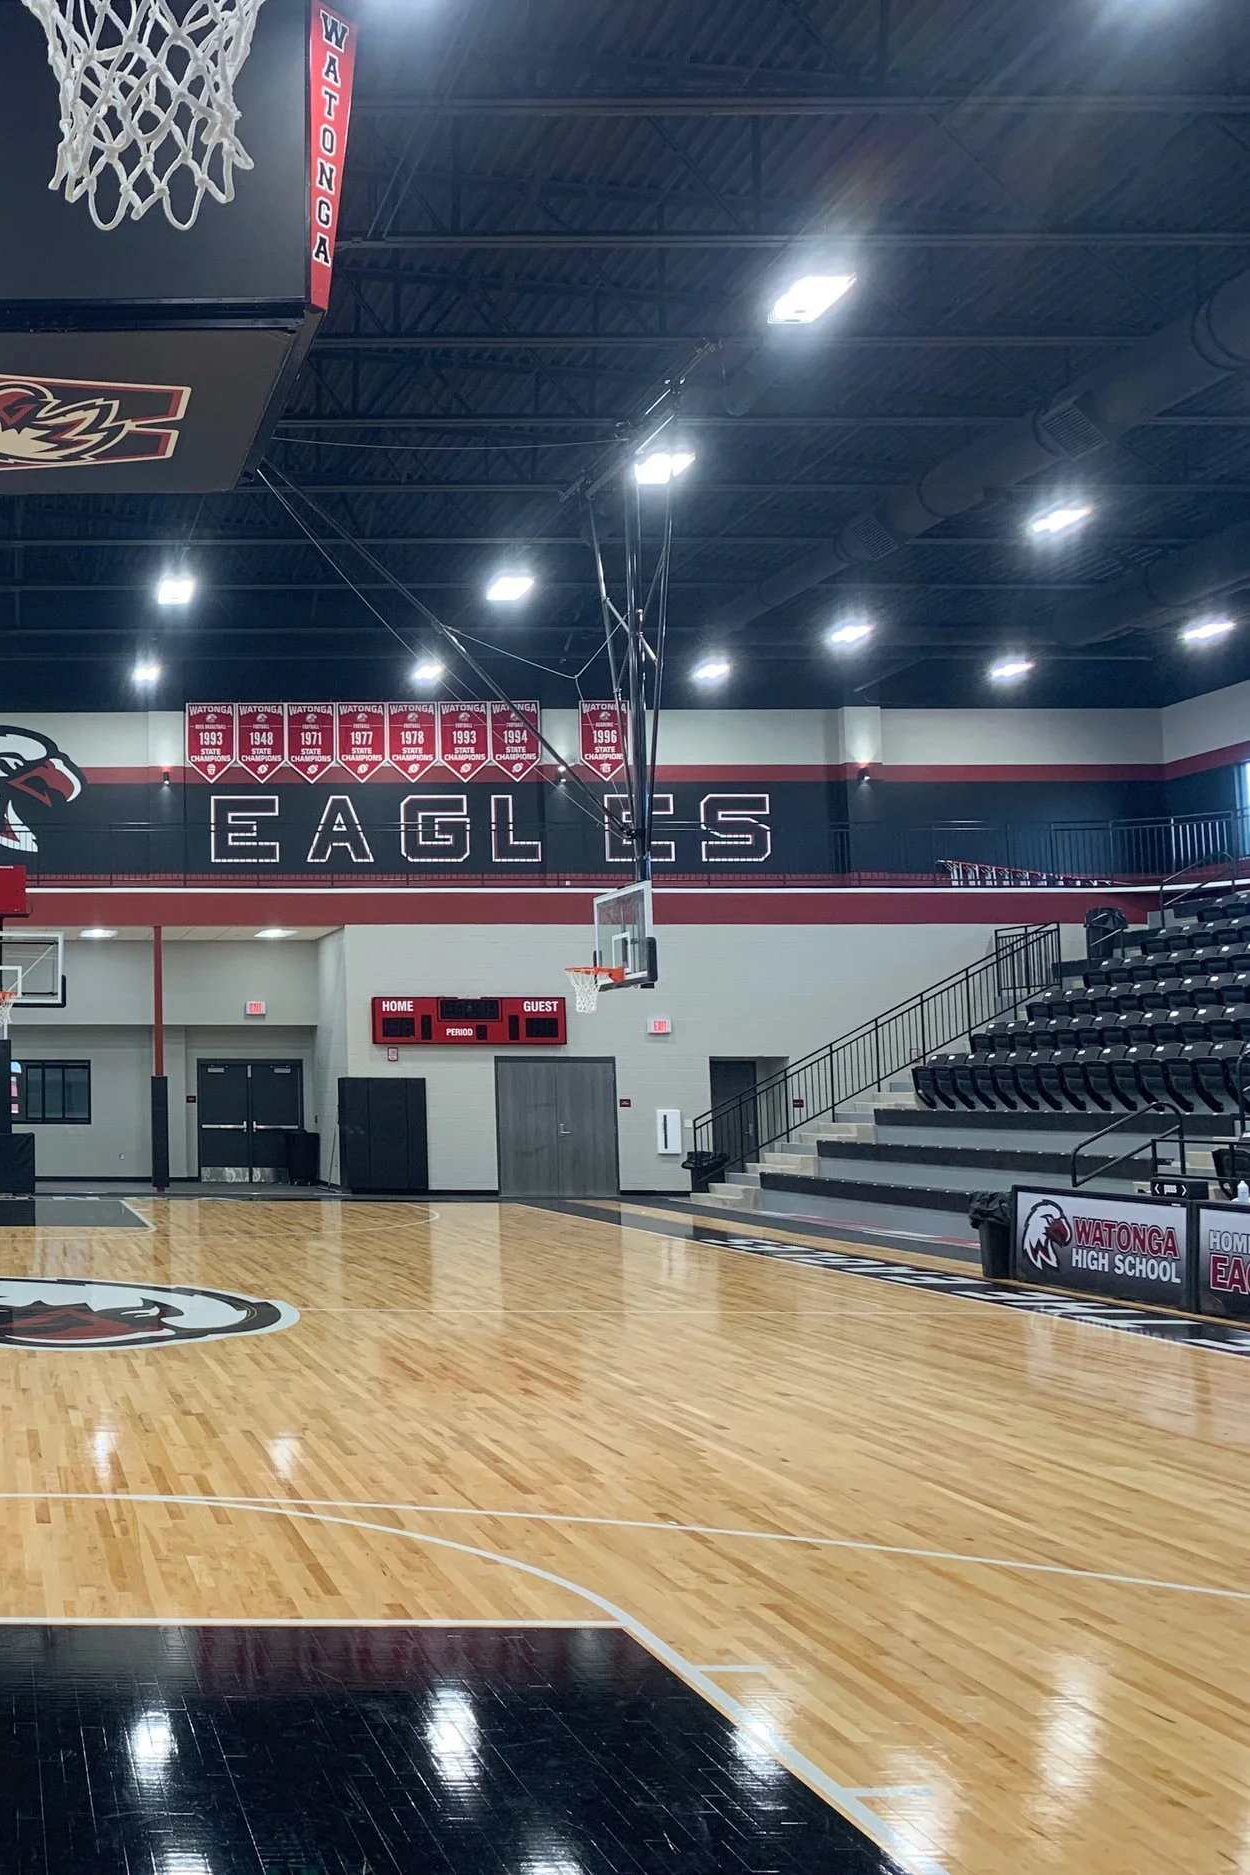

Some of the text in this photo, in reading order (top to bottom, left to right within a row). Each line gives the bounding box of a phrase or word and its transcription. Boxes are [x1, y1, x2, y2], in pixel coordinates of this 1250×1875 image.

[314, 8, 350, 268] WATONGA
[189, 706, 232, 716] WATONGA
[240, 706, 282, 716] WATONGA
[289, 706, 332, 716] WATONGA
[339, 705, 383, 715] WATONGA
[390, 704, 434, 715] WATONGA
[441, 704, 486, 714] WATONGA
[199, 732, 222, 745] 1993
[250, 732, 273, 745] 1948
[300, 732, 322, 745] 1971
[350, 731, 373, 745] 1977
[401, 731, 424, 744] 1978
[452, 731, 476, 744] 1993
[503, 730, 527, 743] 1994
[592, 730, 617, 743] 1996
[210, 794, 771, 862] EAGLES
[382, 1001, 558, 1012] HOME GUEST
[446, 1028, 472, 1036] PERIOD
[1073, 1217, 1180, 1260] WATONGA
[1209, 1230, 1250, 1254] HOM
[1072, 1248, 1181, 1284] HIGH SCHOOL
[1210, 1253, 1250, 1294] EA
